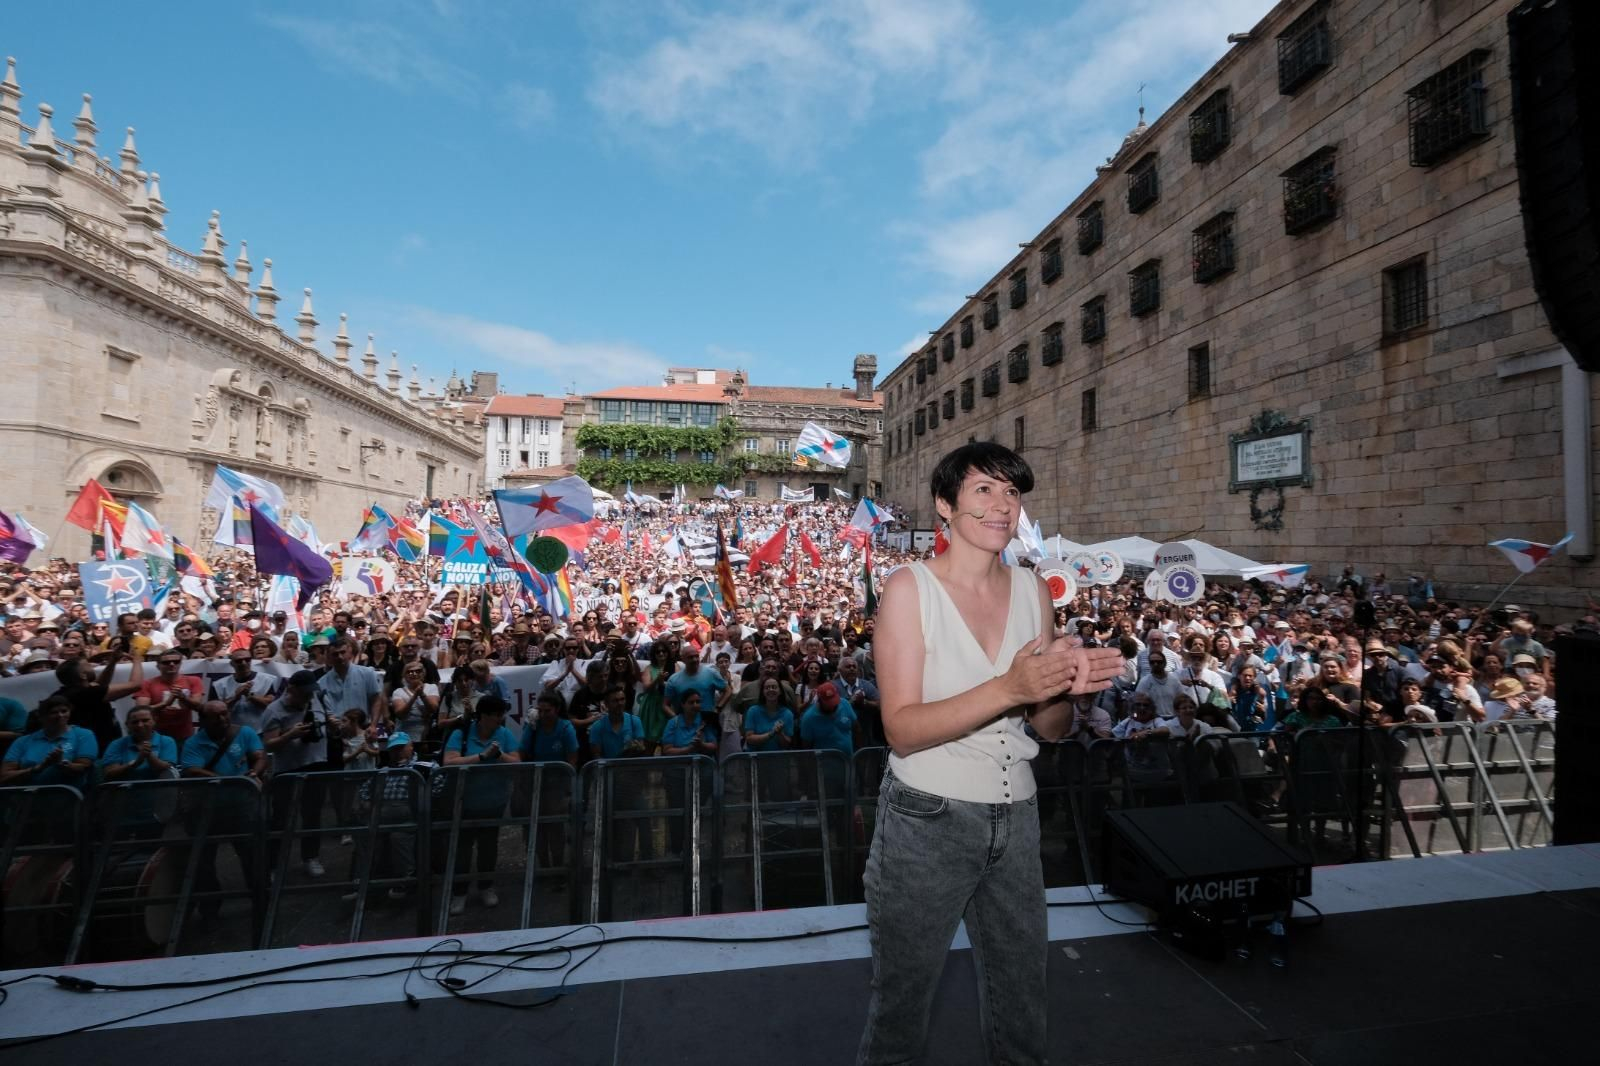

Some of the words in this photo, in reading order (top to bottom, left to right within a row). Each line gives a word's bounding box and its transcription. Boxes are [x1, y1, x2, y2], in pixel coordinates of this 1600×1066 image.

[1163, 554, 1194, 564] ERGUER
[443, 561, 487, 574] GALIZA
[446, 572, 480, 583] NOVA
[495, 571, 522, 582] NOV
[1175, 877, 1260, 905] KACHET
